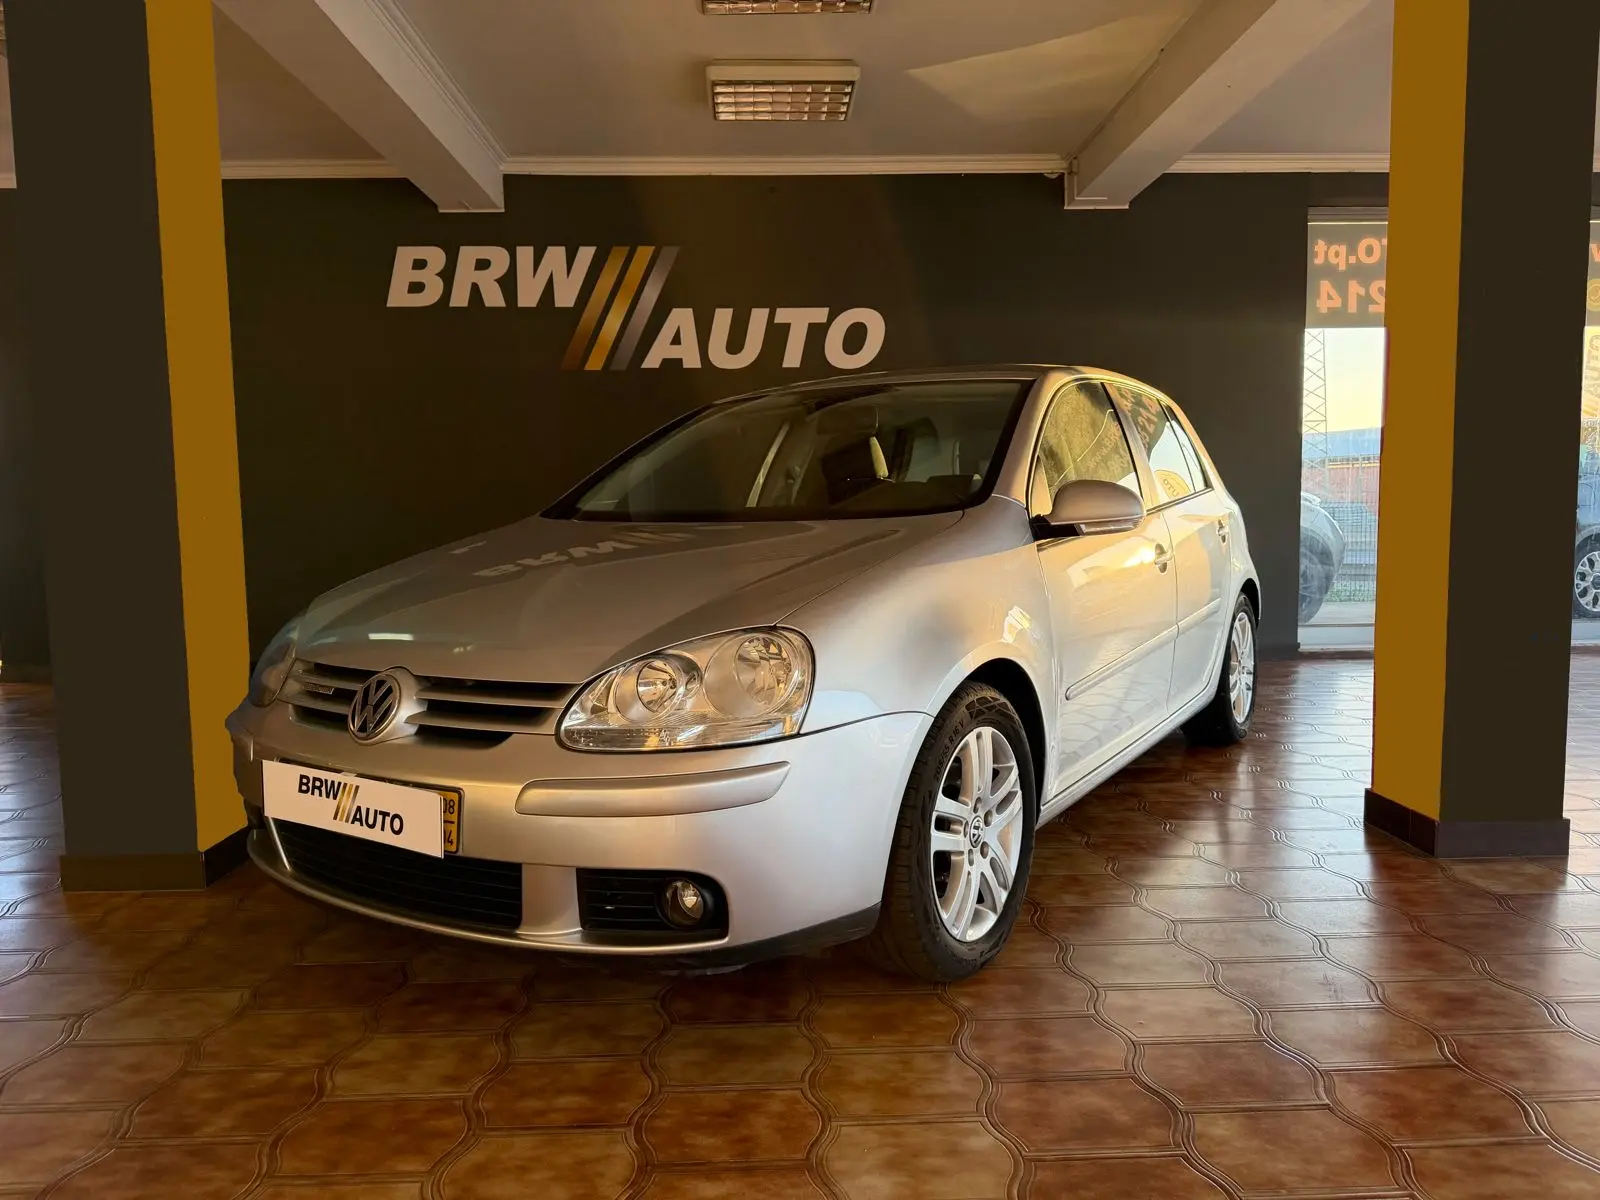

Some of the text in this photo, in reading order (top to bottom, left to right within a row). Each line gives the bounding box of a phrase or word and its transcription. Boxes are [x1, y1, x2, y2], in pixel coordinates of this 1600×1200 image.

[386, 245, 597, 308] BRW
[640, 307, 886, 370] AUTO
[298, 773, 342, 801] BRW
[351, 804, 404, 836] AUTO
